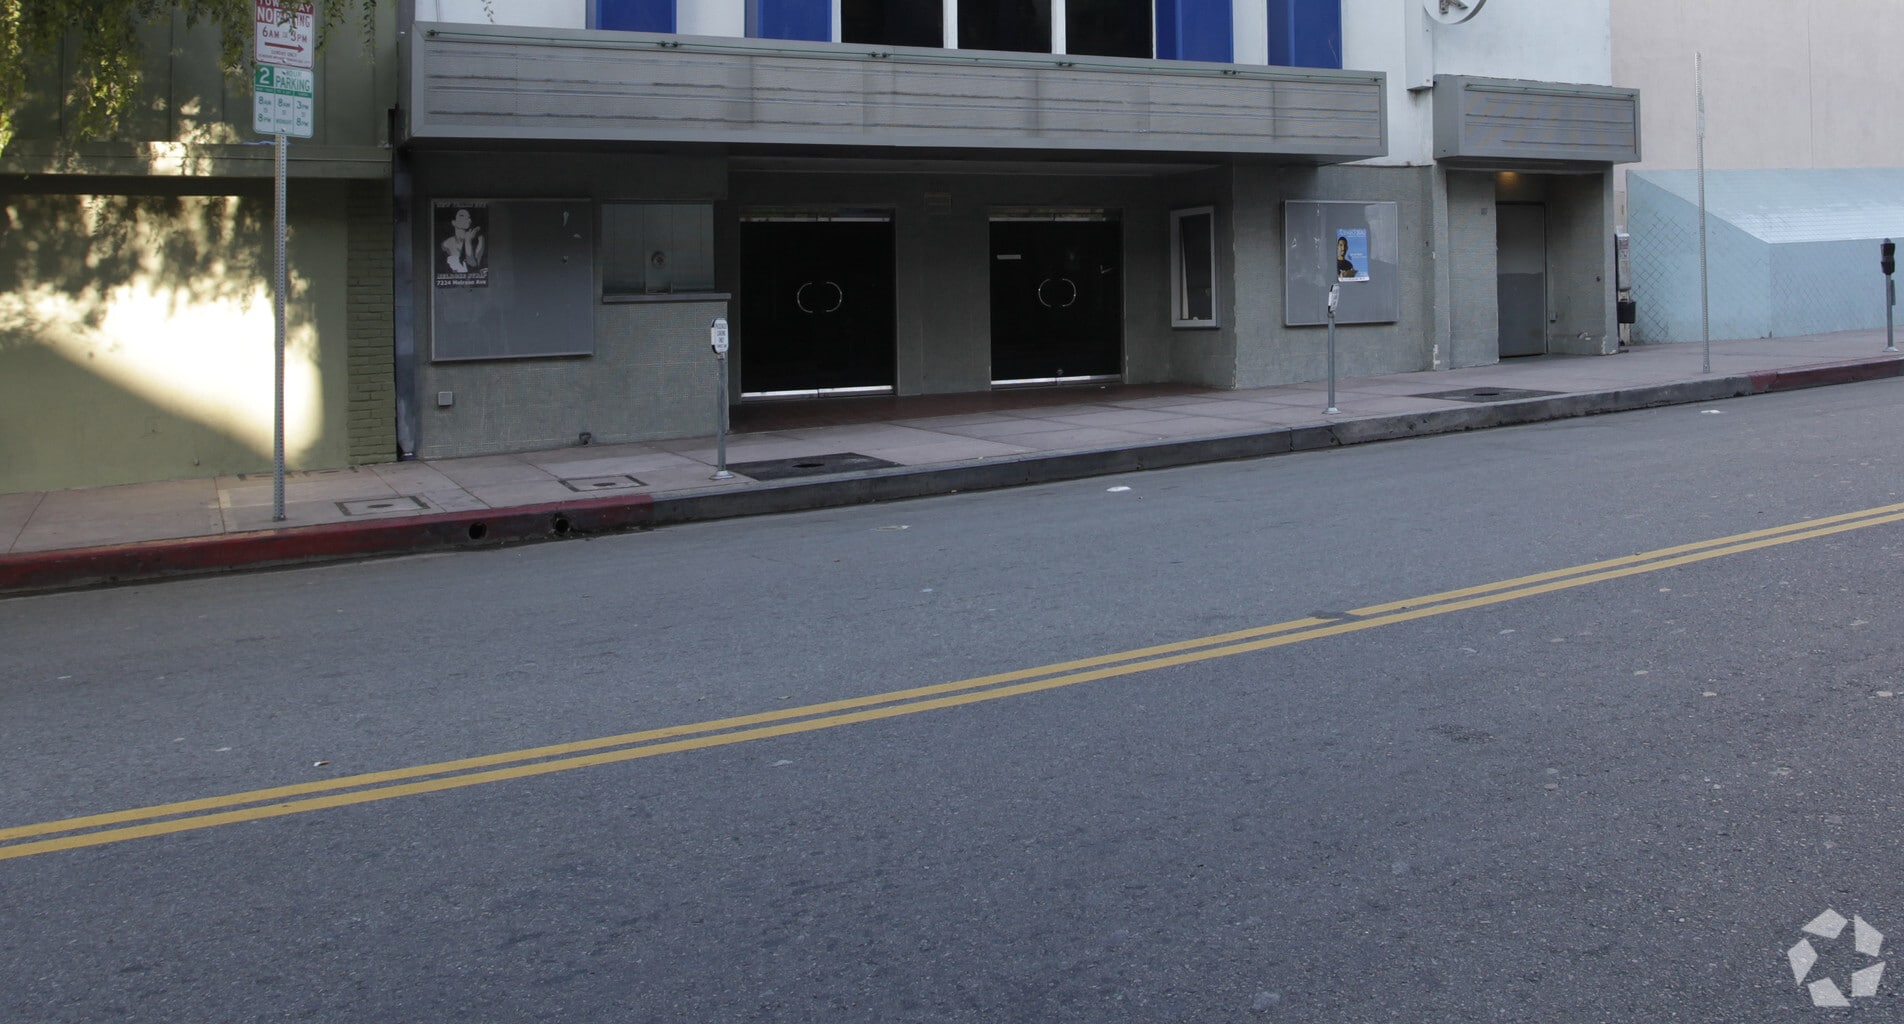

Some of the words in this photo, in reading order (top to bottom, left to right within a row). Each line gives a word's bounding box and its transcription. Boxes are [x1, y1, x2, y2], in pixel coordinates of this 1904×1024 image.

[257, 6, 273, 22] NO
[276, 11, 311, 28] PING
[262, 26, 280, 38] 6AM
[259, 67, 270, 84] 2
[275, 75, 311, 92] PARKING
